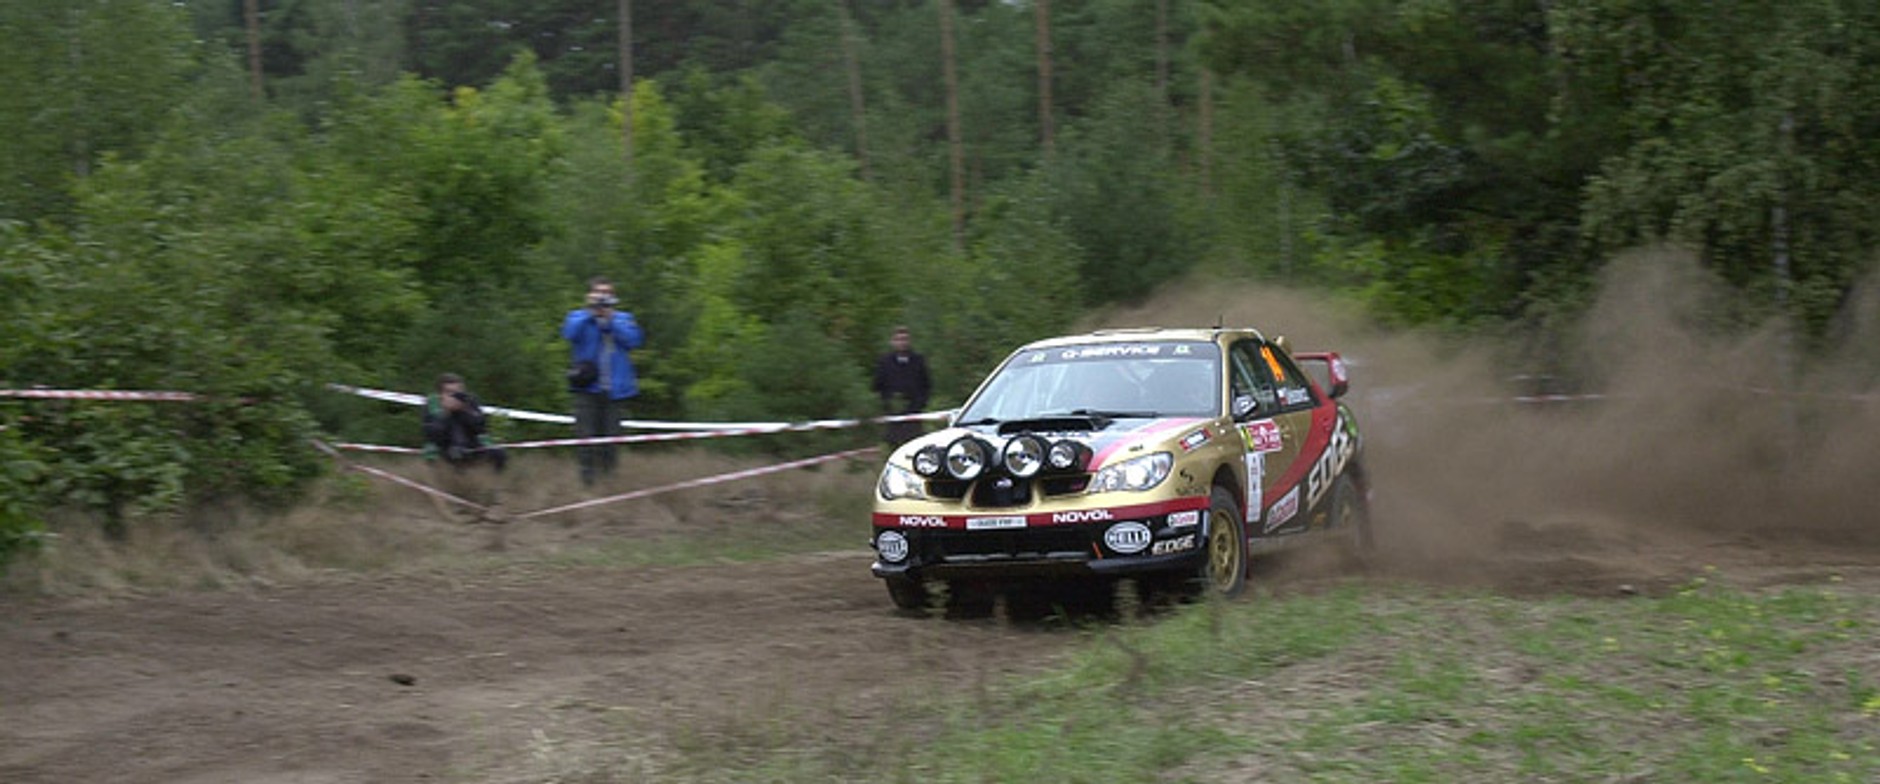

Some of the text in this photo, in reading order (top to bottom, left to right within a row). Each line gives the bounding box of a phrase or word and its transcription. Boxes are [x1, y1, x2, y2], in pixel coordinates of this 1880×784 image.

[900, 516, 948, 527] NOVOL
[1052, 510, 1114, 523] NOVOL
[1152, 534, 1196, 555] EDGE
